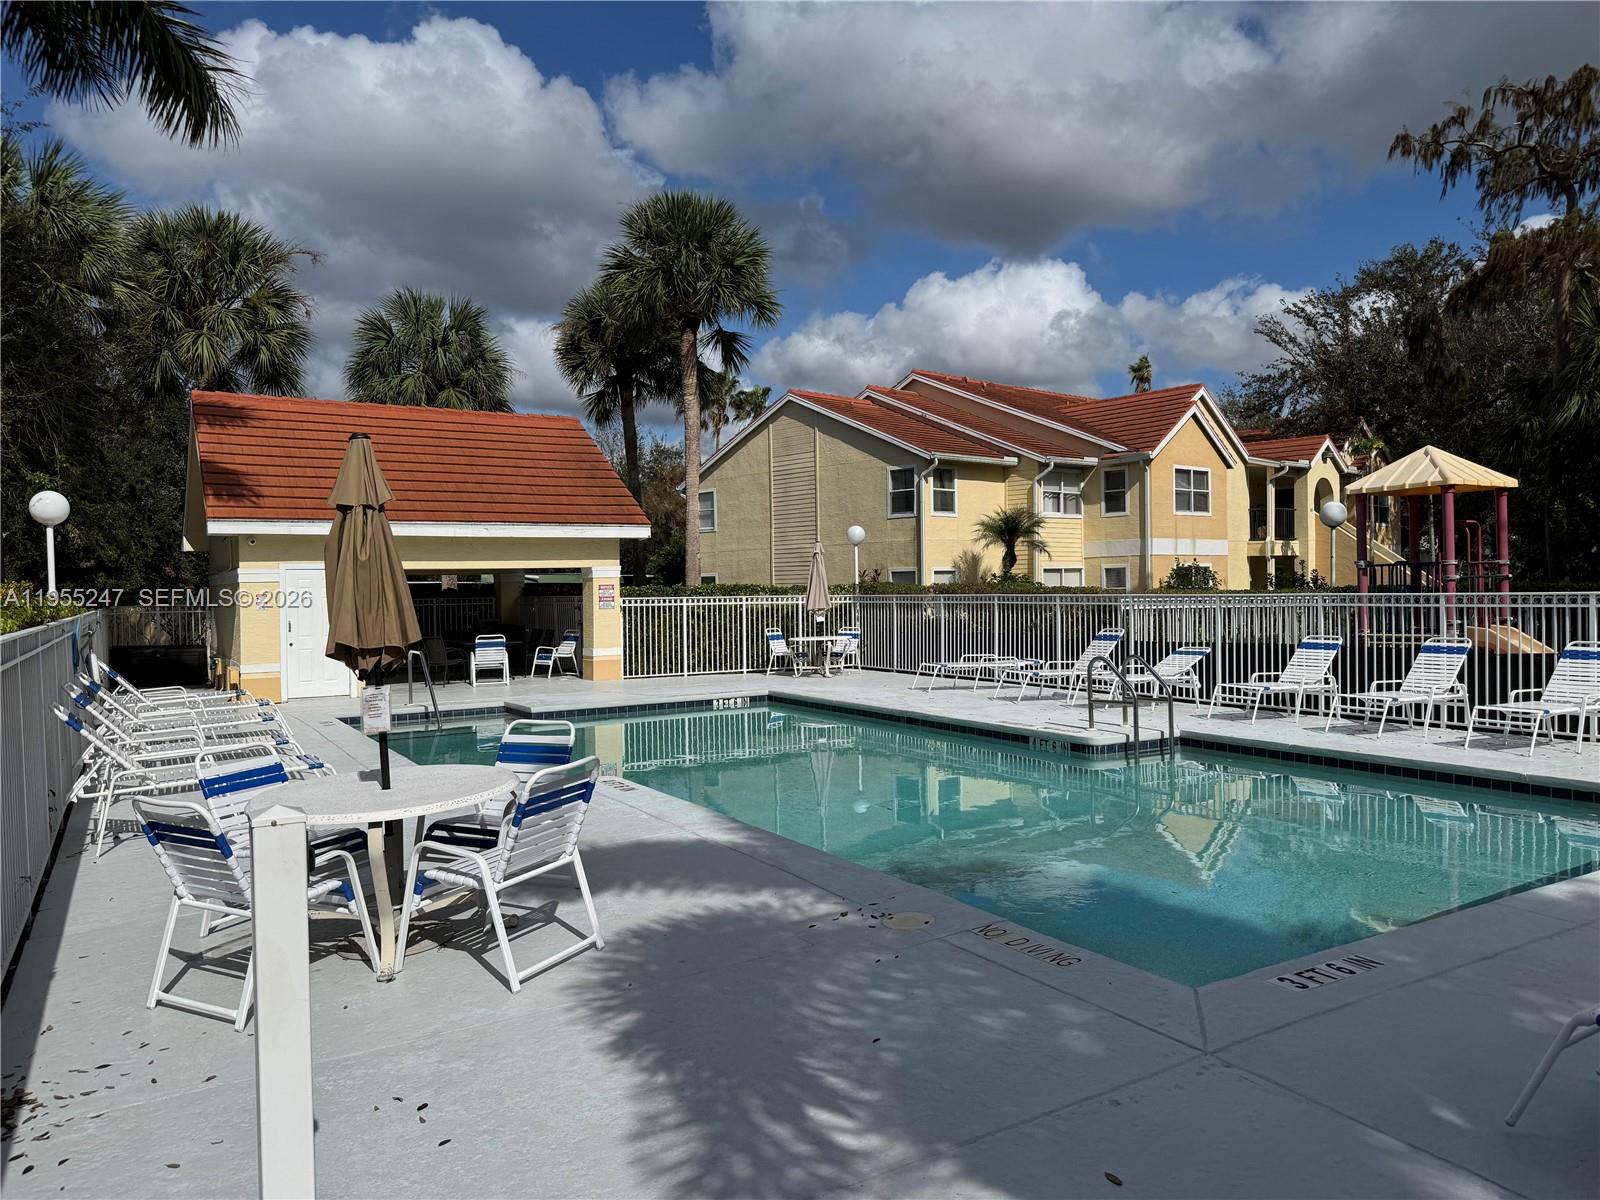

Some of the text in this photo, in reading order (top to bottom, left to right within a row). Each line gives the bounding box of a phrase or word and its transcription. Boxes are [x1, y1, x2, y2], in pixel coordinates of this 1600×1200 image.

[970, 923, 1082, 967] NO DIVING
[1276, 954, 1385, 989] 3 FT 6 IN
